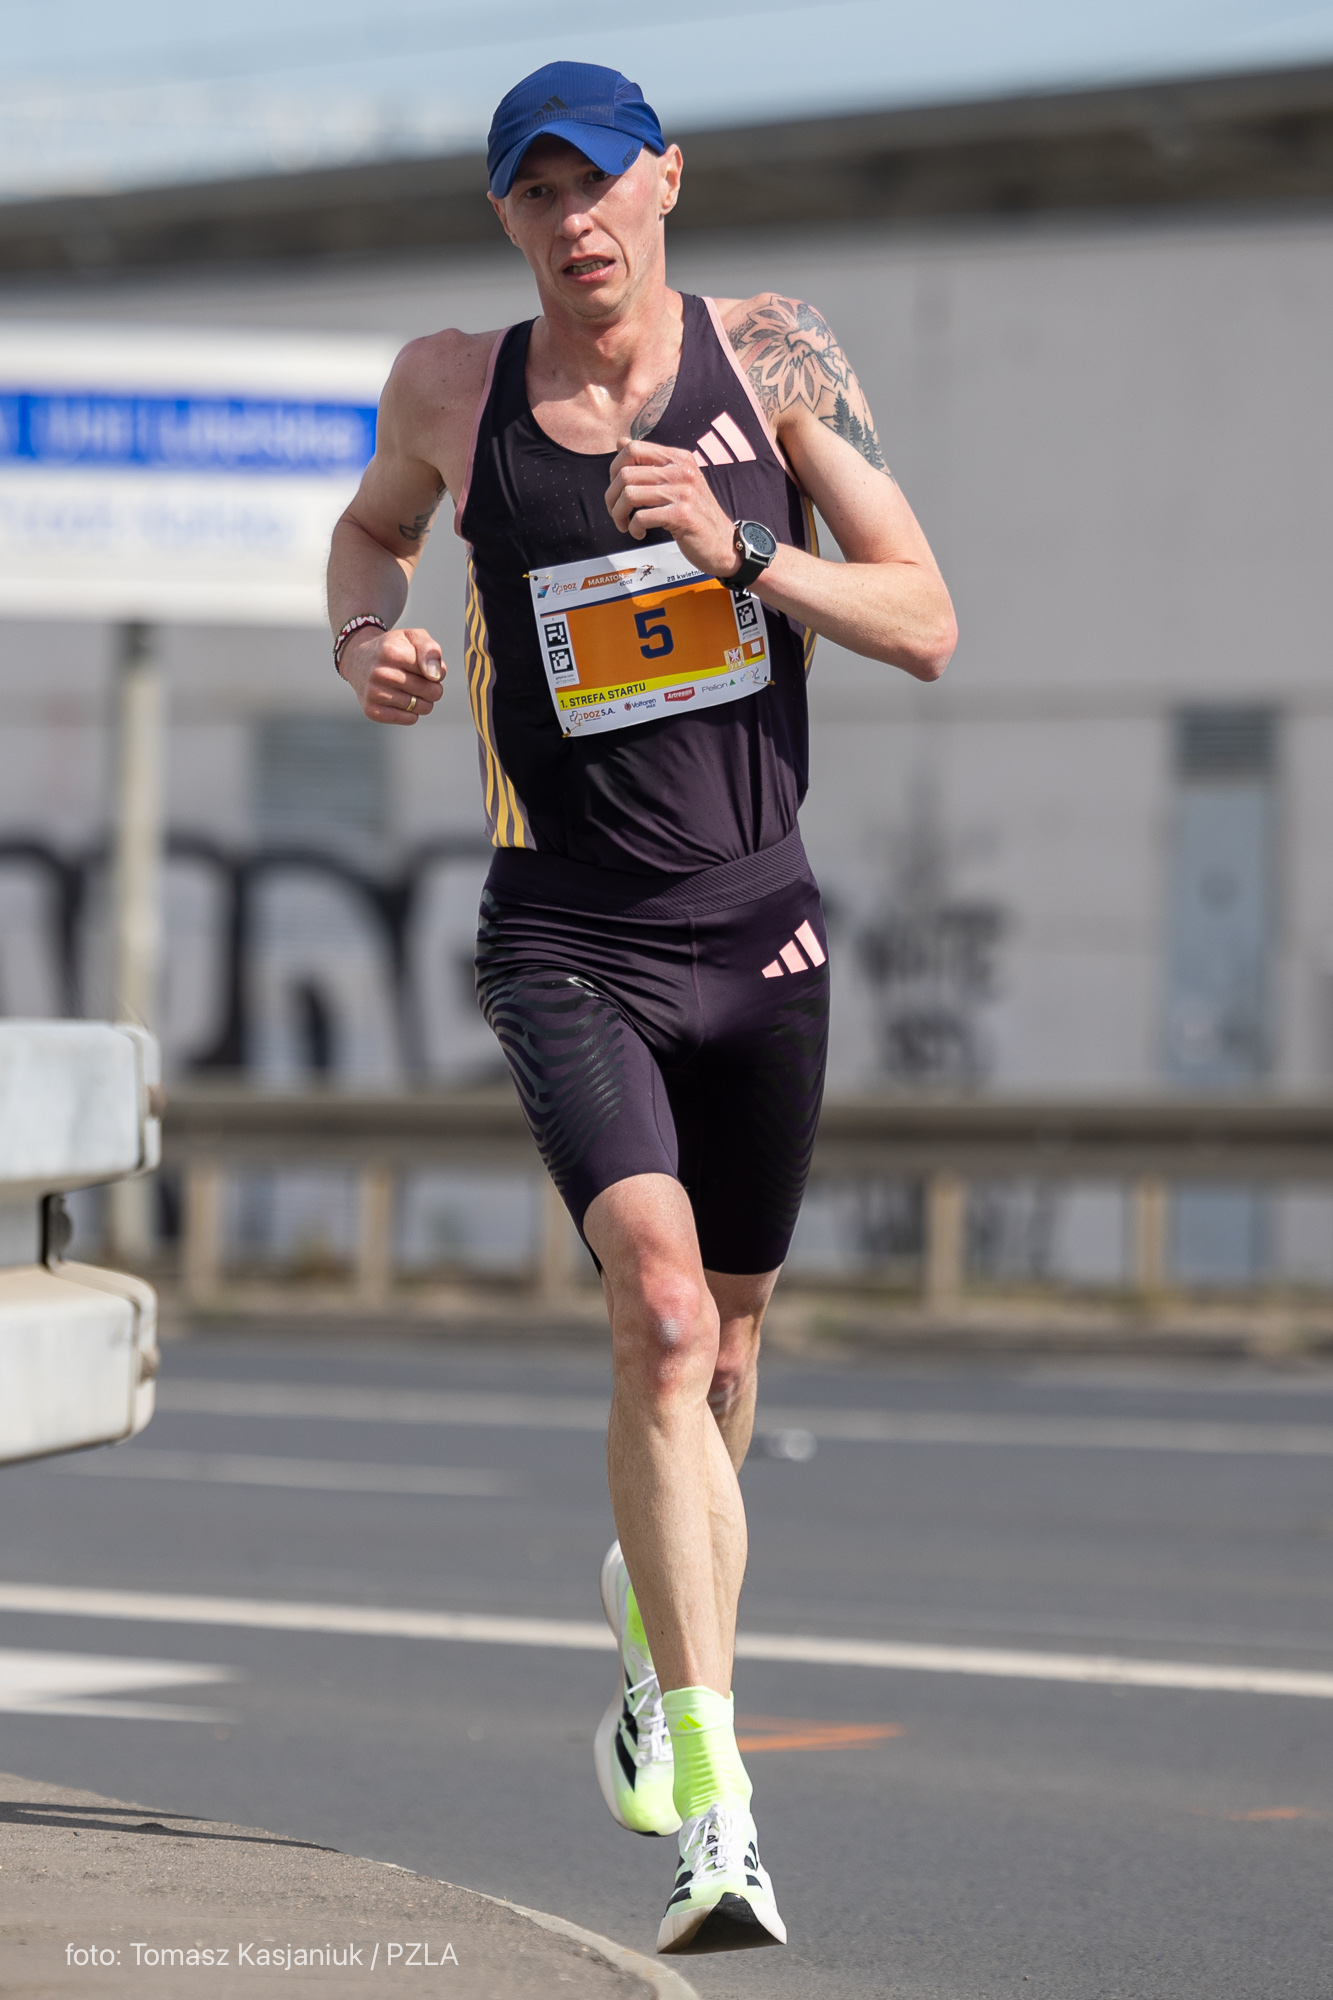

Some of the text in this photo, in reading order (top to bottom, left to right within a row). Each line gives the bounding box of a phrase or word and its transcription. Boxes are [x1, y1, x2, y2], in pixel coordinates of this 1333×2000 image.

[588, 573, 625, 586] MARATON
[563, 583, 577, 591] DOZ
[634, 607, 674, 659] 5
[701, 682, 728, 693] Pelion
[561, 682, 646, 708] 1. STREFA STARTU
[632, 698, 657, 708] Voltaren
[583, 710, 601, 720] DOZ
